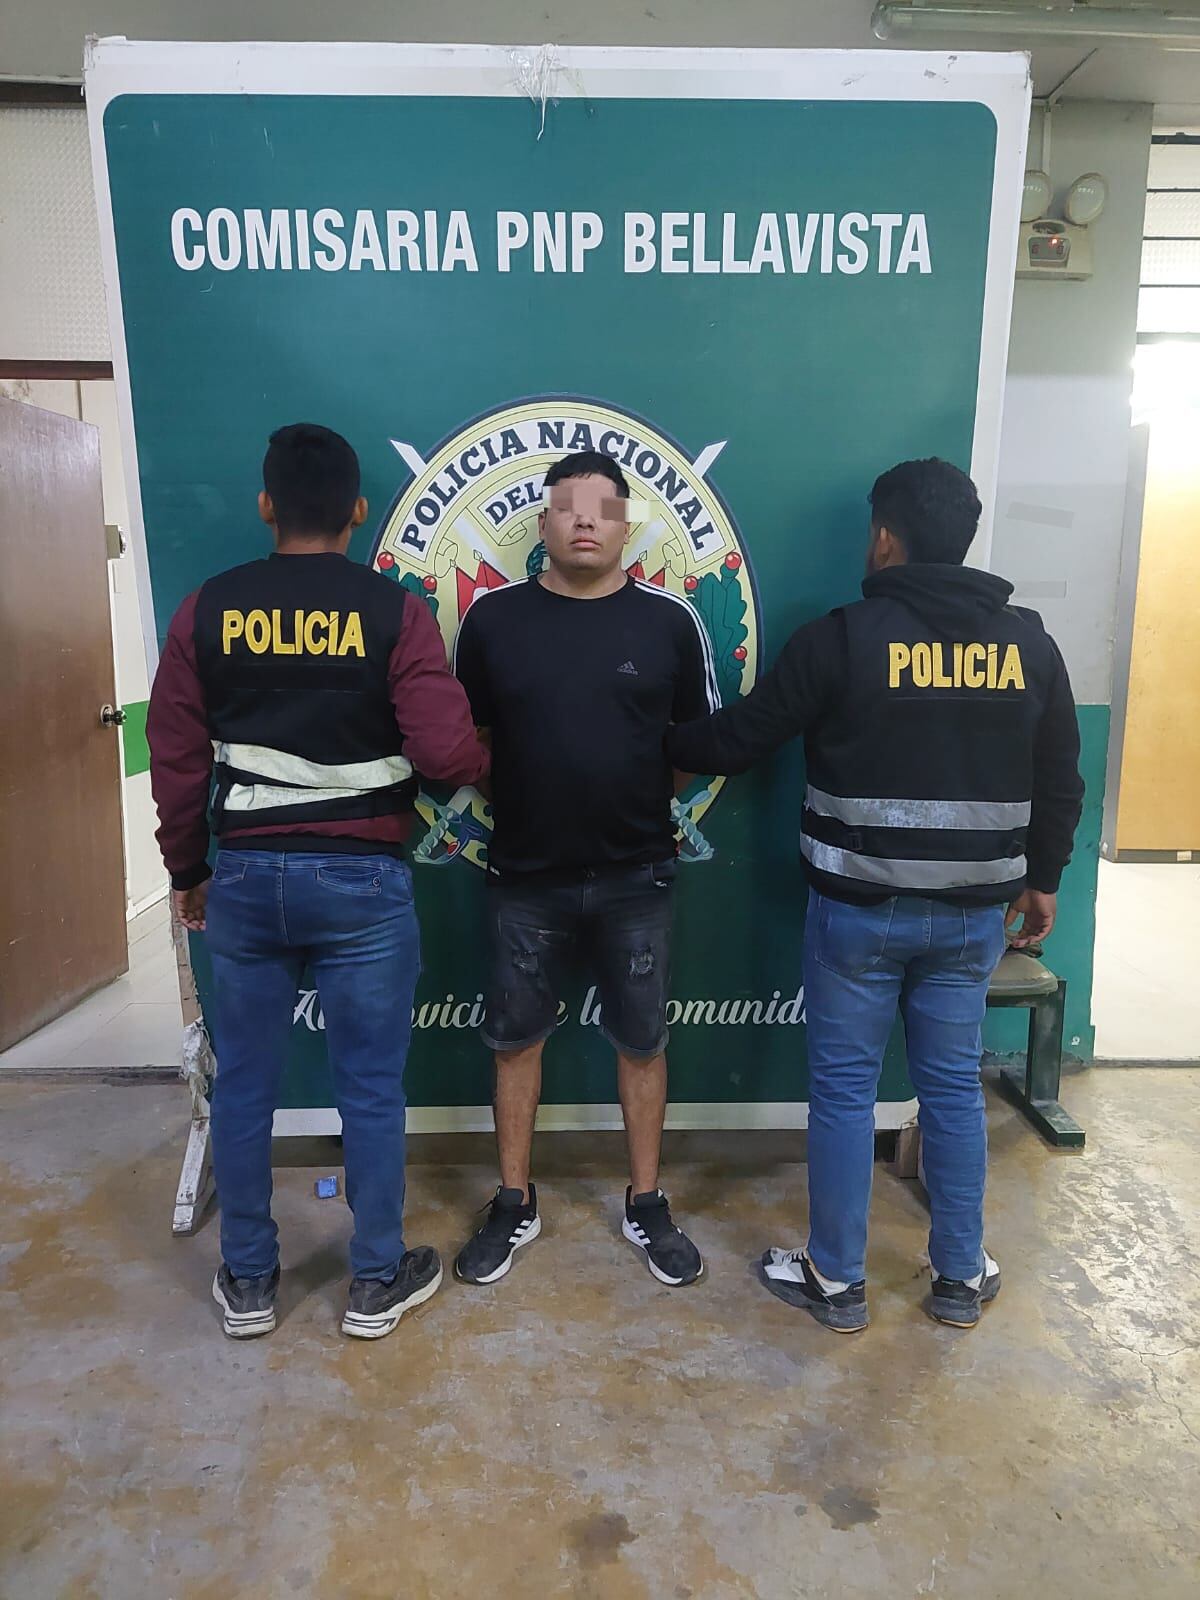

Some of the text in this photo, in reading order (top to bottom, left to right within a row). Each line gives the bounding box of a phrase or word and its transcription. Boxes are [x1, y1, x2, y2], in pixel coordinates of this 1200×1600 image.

[171, 207, 933, 275] COMISARIA PNP BELLAVISTA
[401, 420, 715, 553] POLICIA NACIONAL
[485, 481, 544, 526] DEL
[665, 985, 807, 1026] omunid
